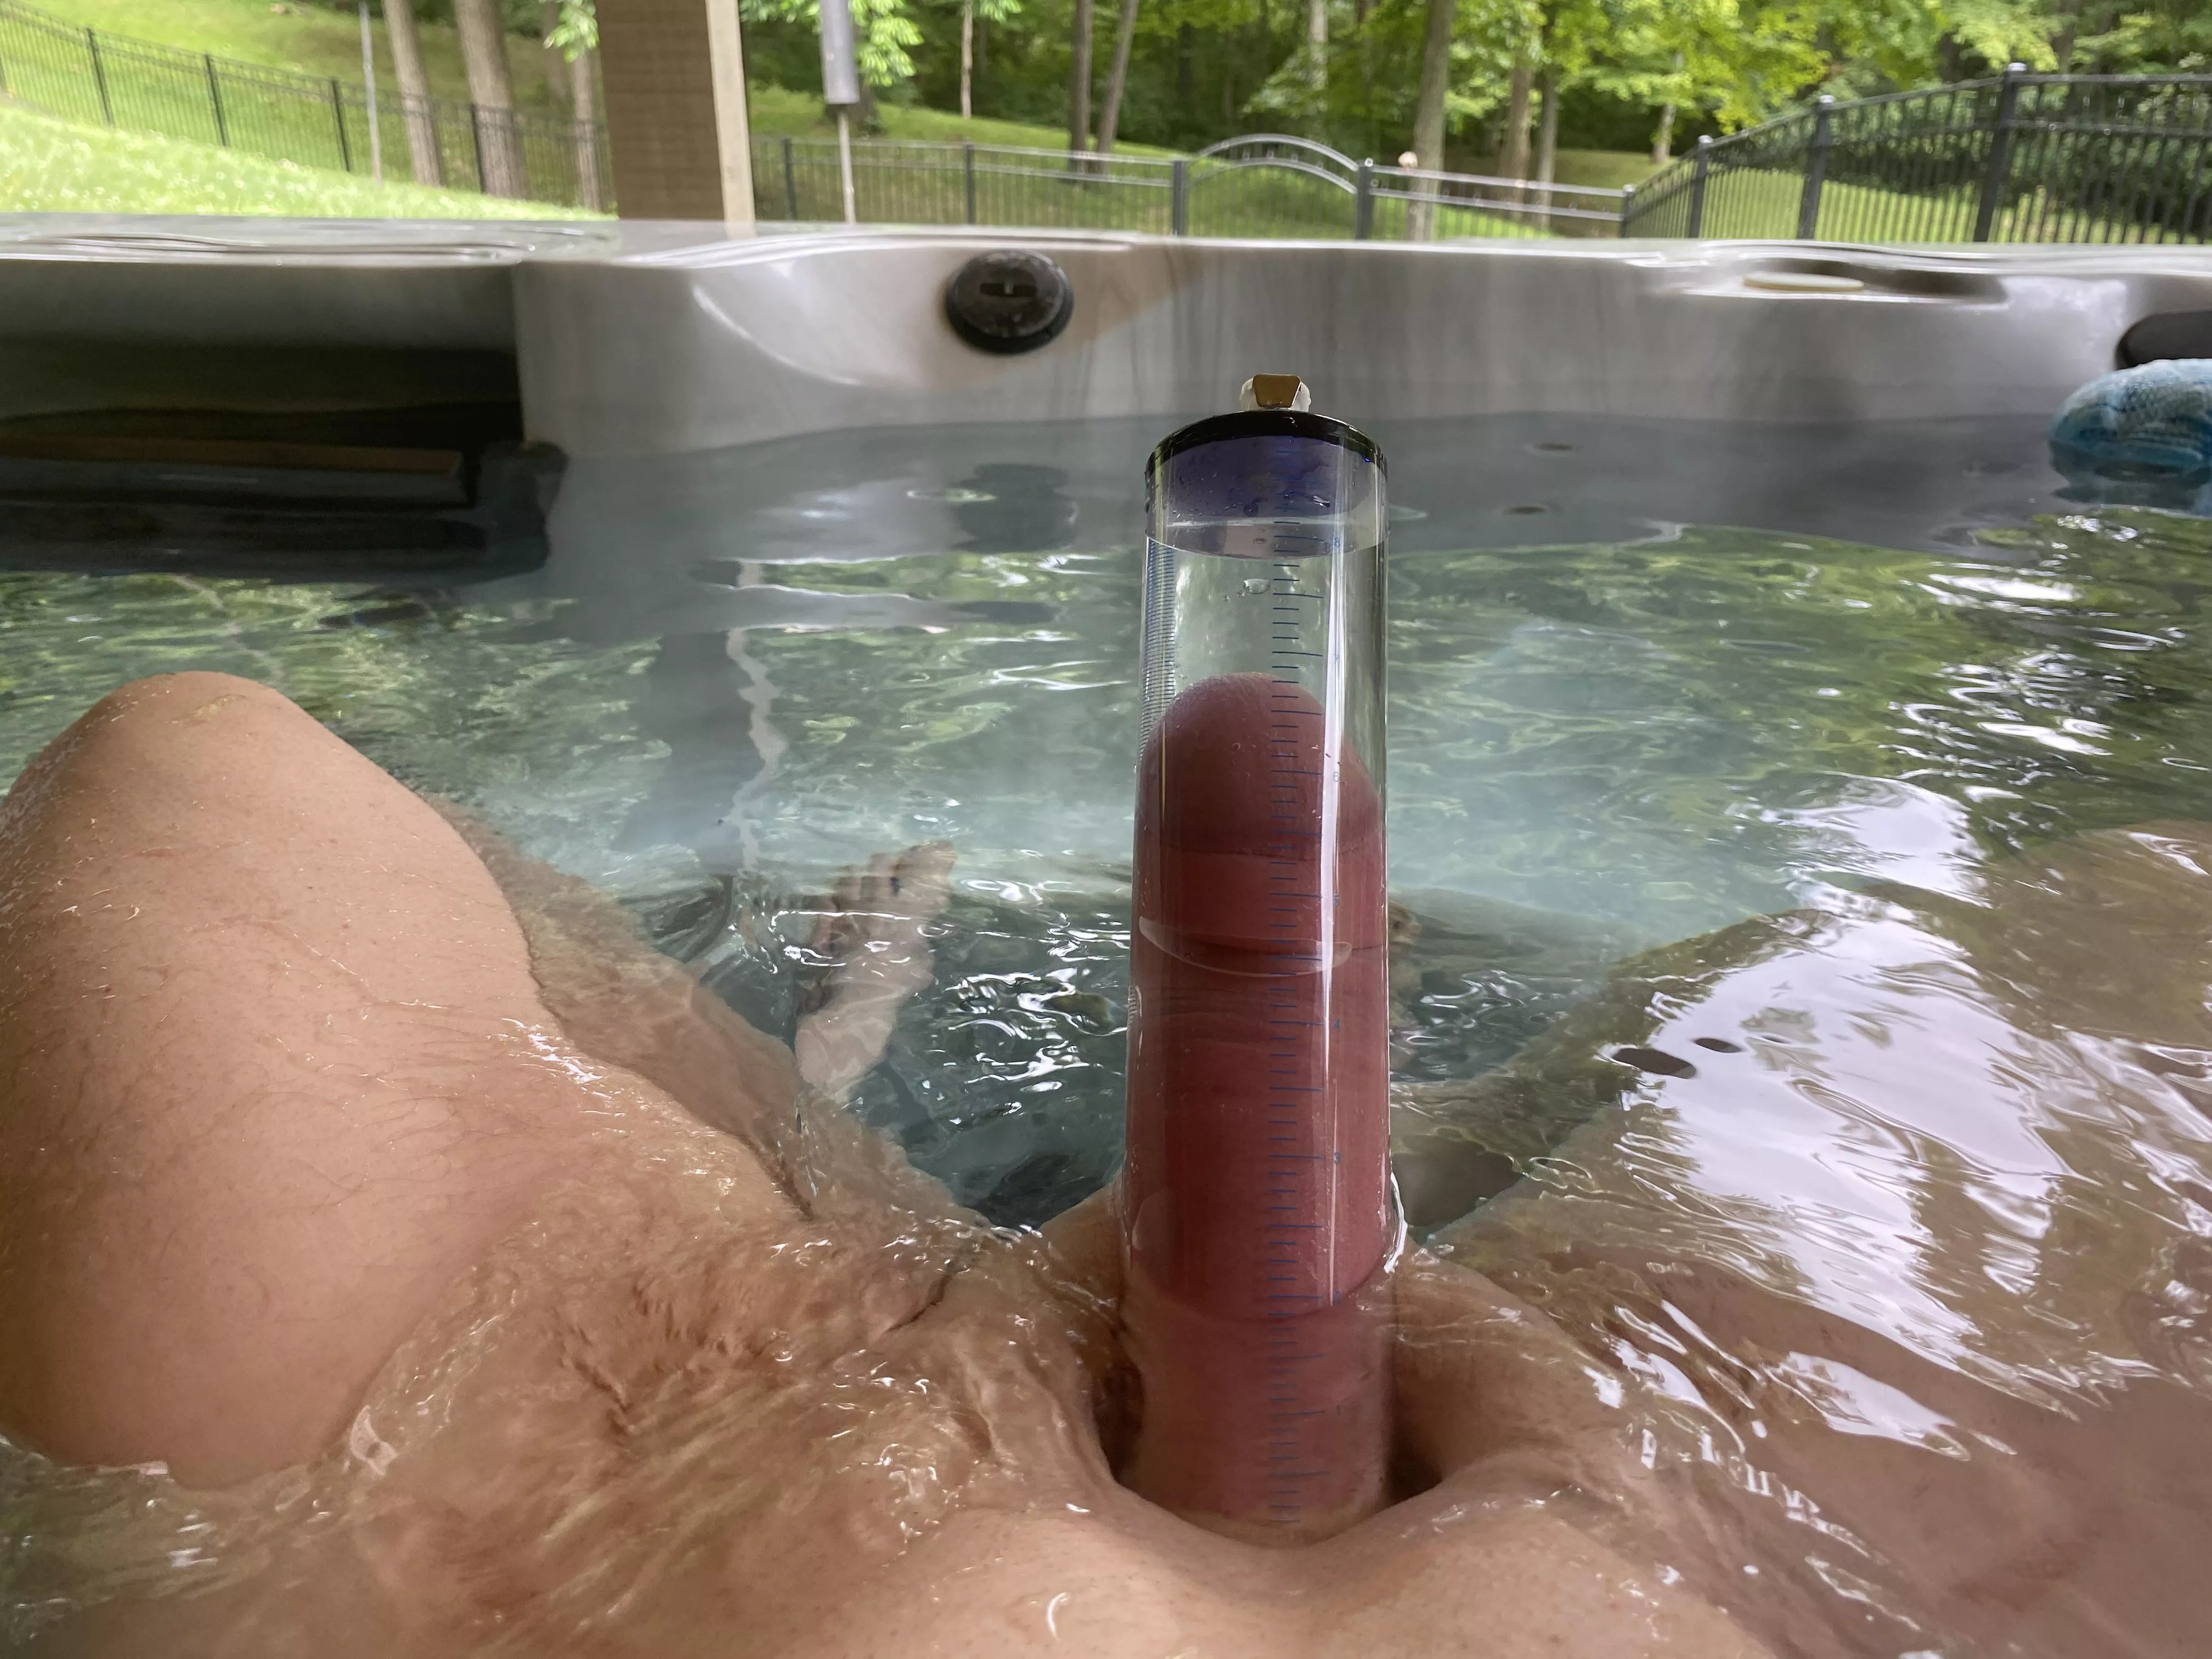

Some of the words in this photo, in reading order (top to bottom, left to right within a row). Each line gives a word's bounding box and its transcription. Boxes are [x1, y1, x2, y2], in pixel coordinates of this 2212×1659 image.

[1334, 537, 1340, 548] 8
[1333, 771, 1340, 782] 6
[1333, 894, 1340, 905] 5
[1333, 1019, 1340, 1028] 4
[1334, 1152, 1340, 1164] 3
